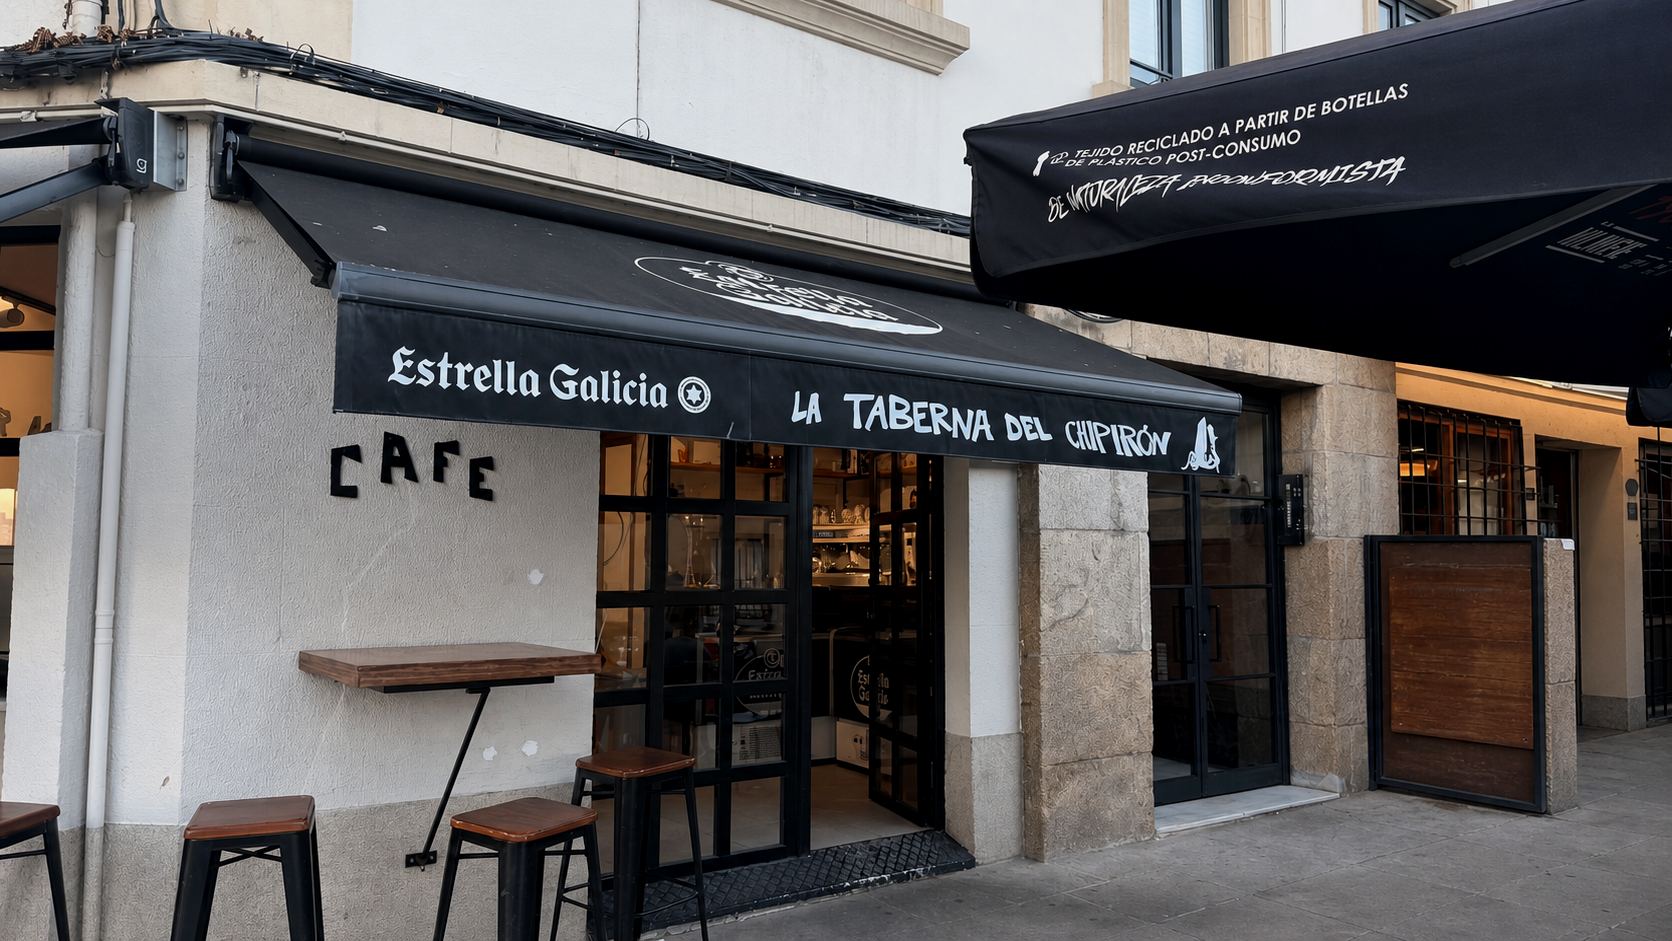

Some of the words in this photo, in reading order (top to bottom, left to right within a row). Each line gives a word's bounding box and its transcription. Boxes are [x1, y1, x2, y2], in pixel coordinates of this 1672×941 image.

[1064, 157, 1087, 167] DE
[1087, 155, 1163, 167] PLASTICO
[1164, 129, 1301, 165] POST-CONSUMO
[1074, 144, 1124, 159] TEJIDO
[1126, 125, 1214, 155] RECICLADO
[1217, 122, 1231, 138] A
[1235, 109, 1289, 134] PARTIR
[1293, 102, 1317, 122] DE
[1320, 82, 1409, 116] BOTELLAS
[387, 345, 543, 398] Estrella
[549, 363, 669, 409] Galicia
[791, 390, 822, 425] LA
[843, 393, 995, 443] TABERNA
[1004, 412, 1054, 442] DEL
[1064, 419, 1172, 458] CHIPIRÓN
[330, 430, 496, 502] CAFE
